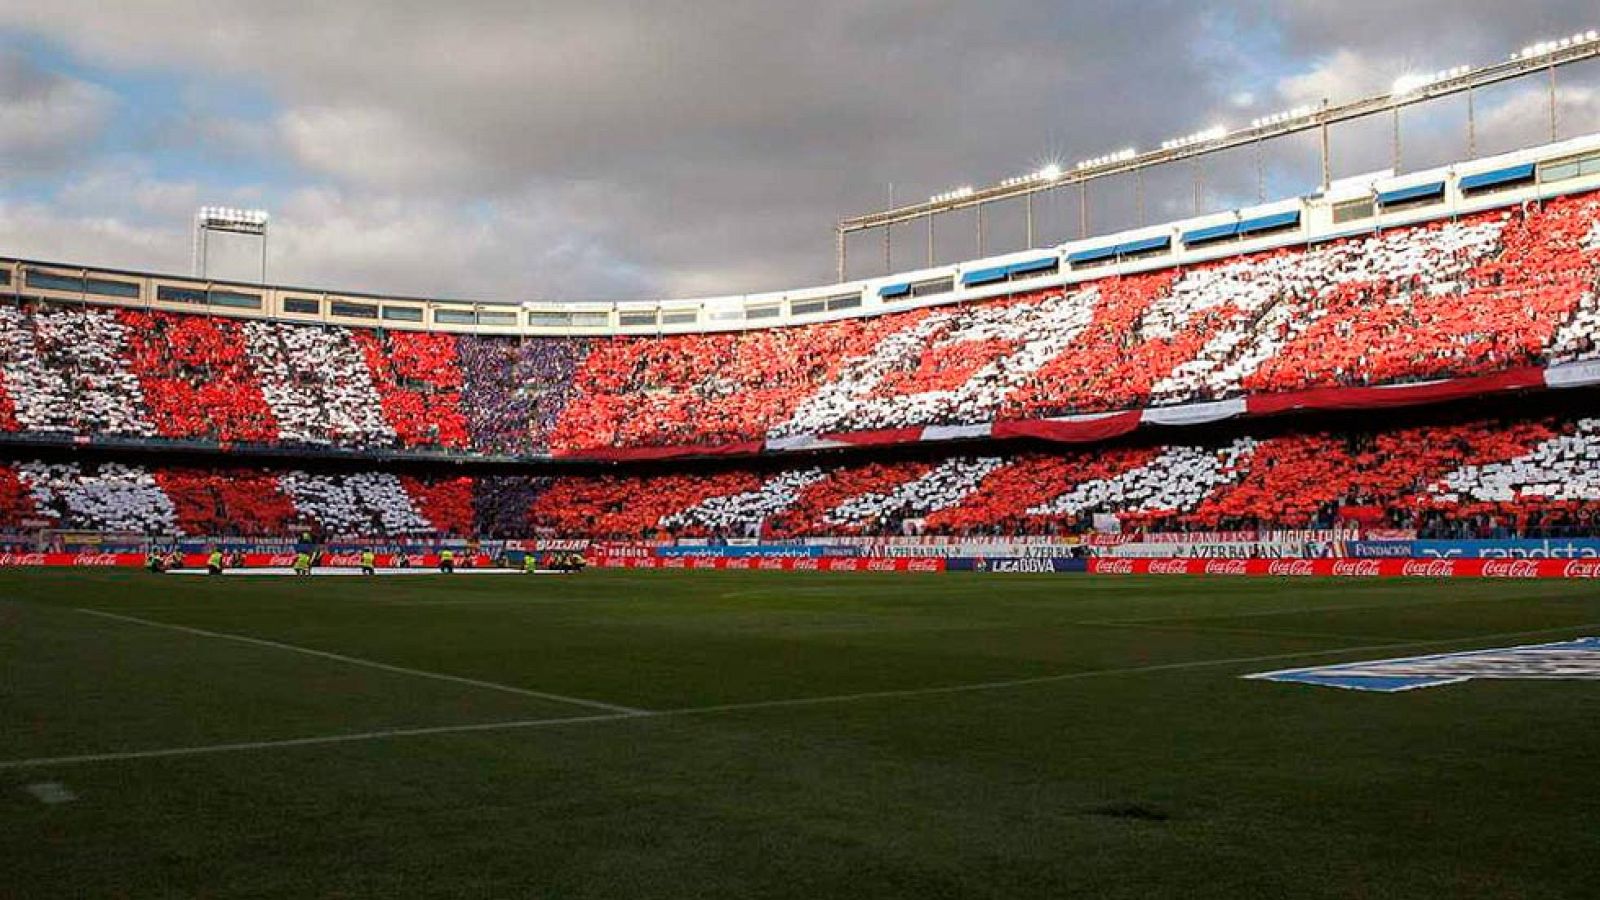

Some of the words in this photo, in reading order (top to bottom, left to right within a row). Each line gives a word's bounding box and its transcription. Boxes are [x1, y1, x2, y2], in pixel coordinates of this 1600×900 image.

[1148, 560, 1187, 574] Coca-Cola
[1205, 560, 1247, 574] Coca-Cola
[1268, 560, 1314, 575] Coca-Cola
[1332, 560, 1380, 576] Coca-Cola
[1402, 560, 1454, 576] Coca-Cola
[1481, 560, 1539, 577] Coca-Cola
